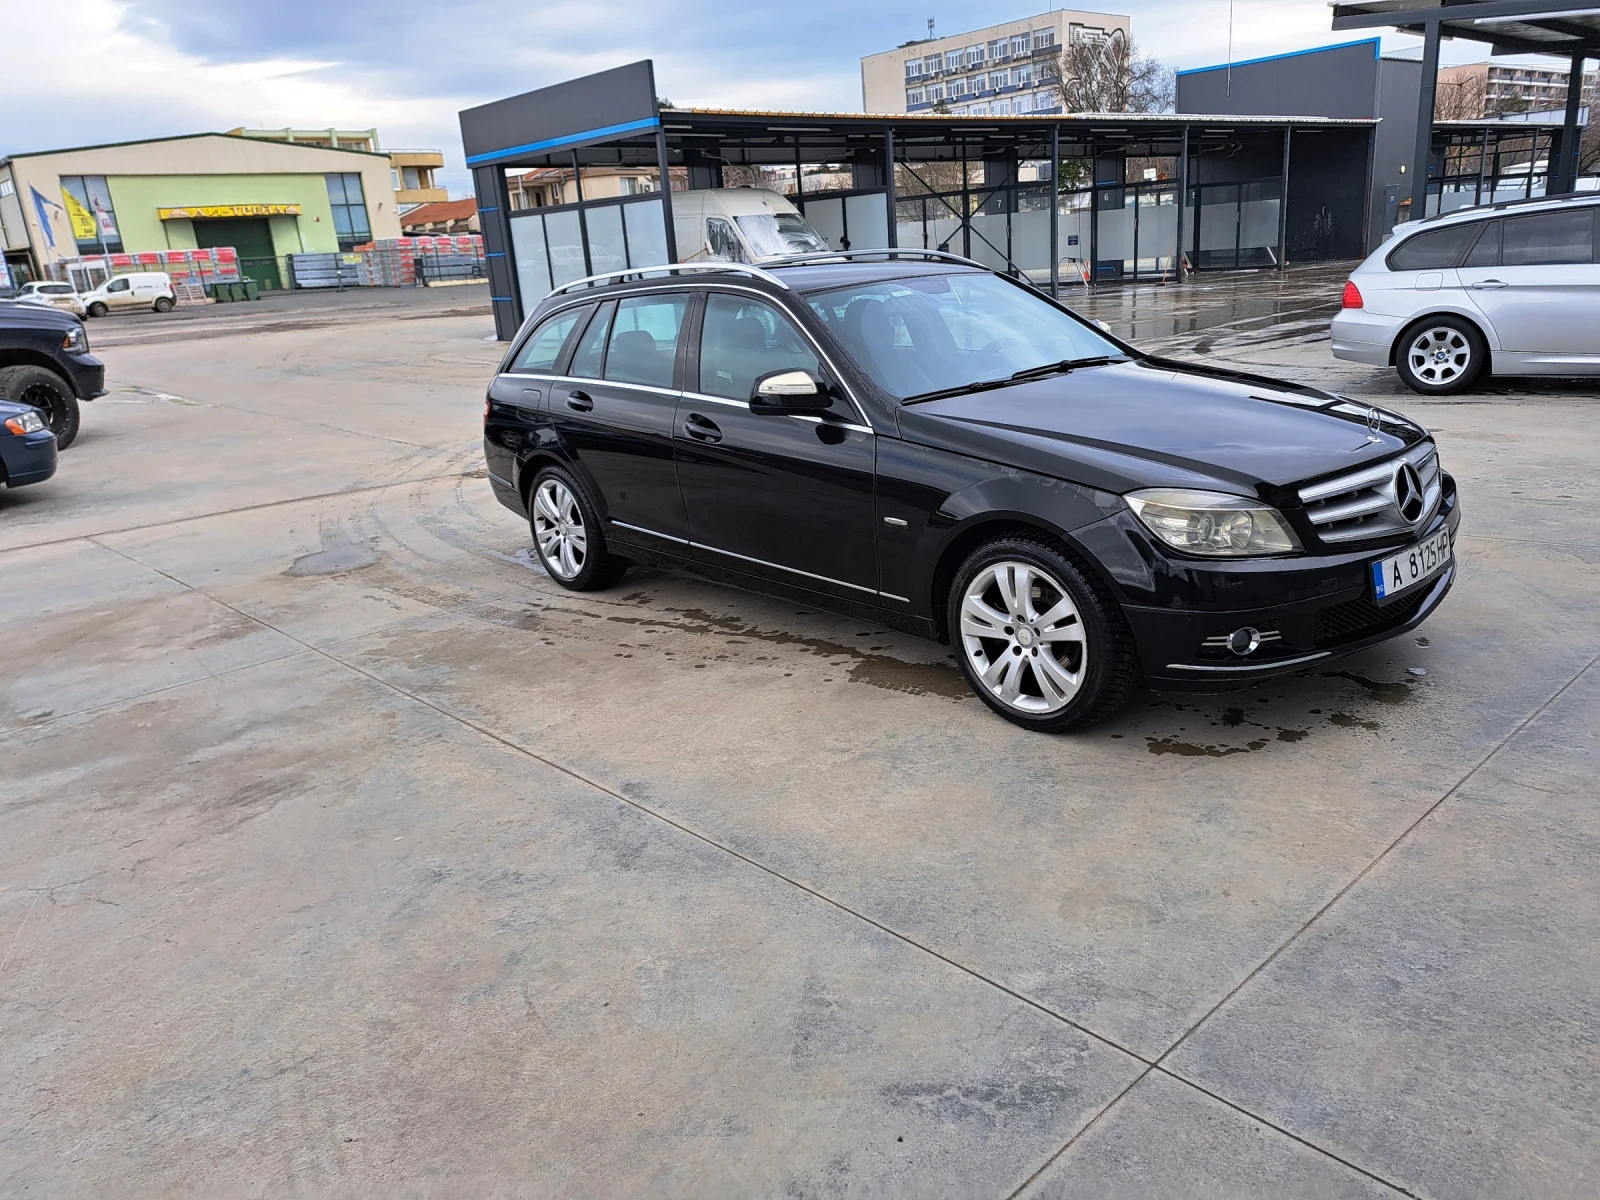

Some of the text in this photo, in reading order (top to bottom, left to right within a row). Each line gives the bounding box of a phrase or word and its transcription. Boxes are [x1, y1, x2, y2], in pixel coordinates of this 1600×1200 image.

[1104, 193, 1109, 201] 6
[996, 199, 1002, 208] 7
[1393, 560, 1403, 588] A
[1376, 584, 1384, 594] BG
